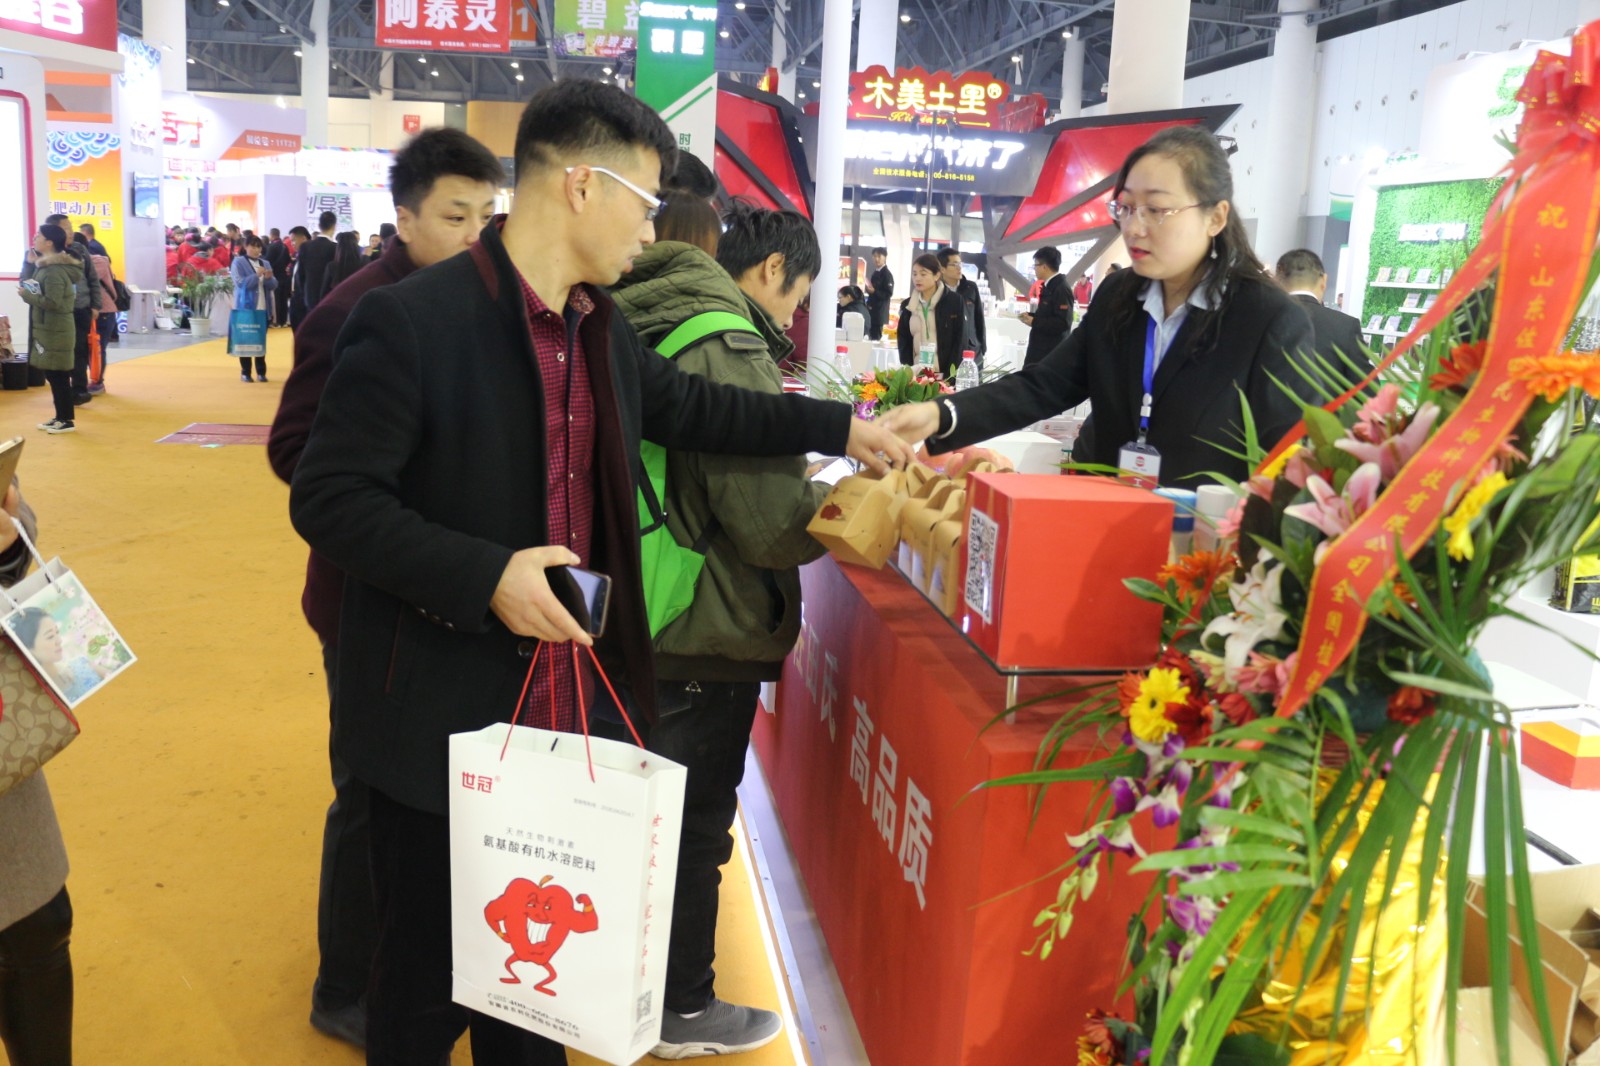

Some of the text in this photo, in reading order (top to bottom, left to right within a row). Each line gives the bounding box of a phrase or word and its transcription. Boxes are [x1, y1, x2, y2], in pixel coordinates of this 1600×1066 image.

[384, 0, 498, 33] 阿泰灵
[850, 694, 933, 912] 高品质
[483, 834, 597, 873] 氨基酸有机水溶肥料
